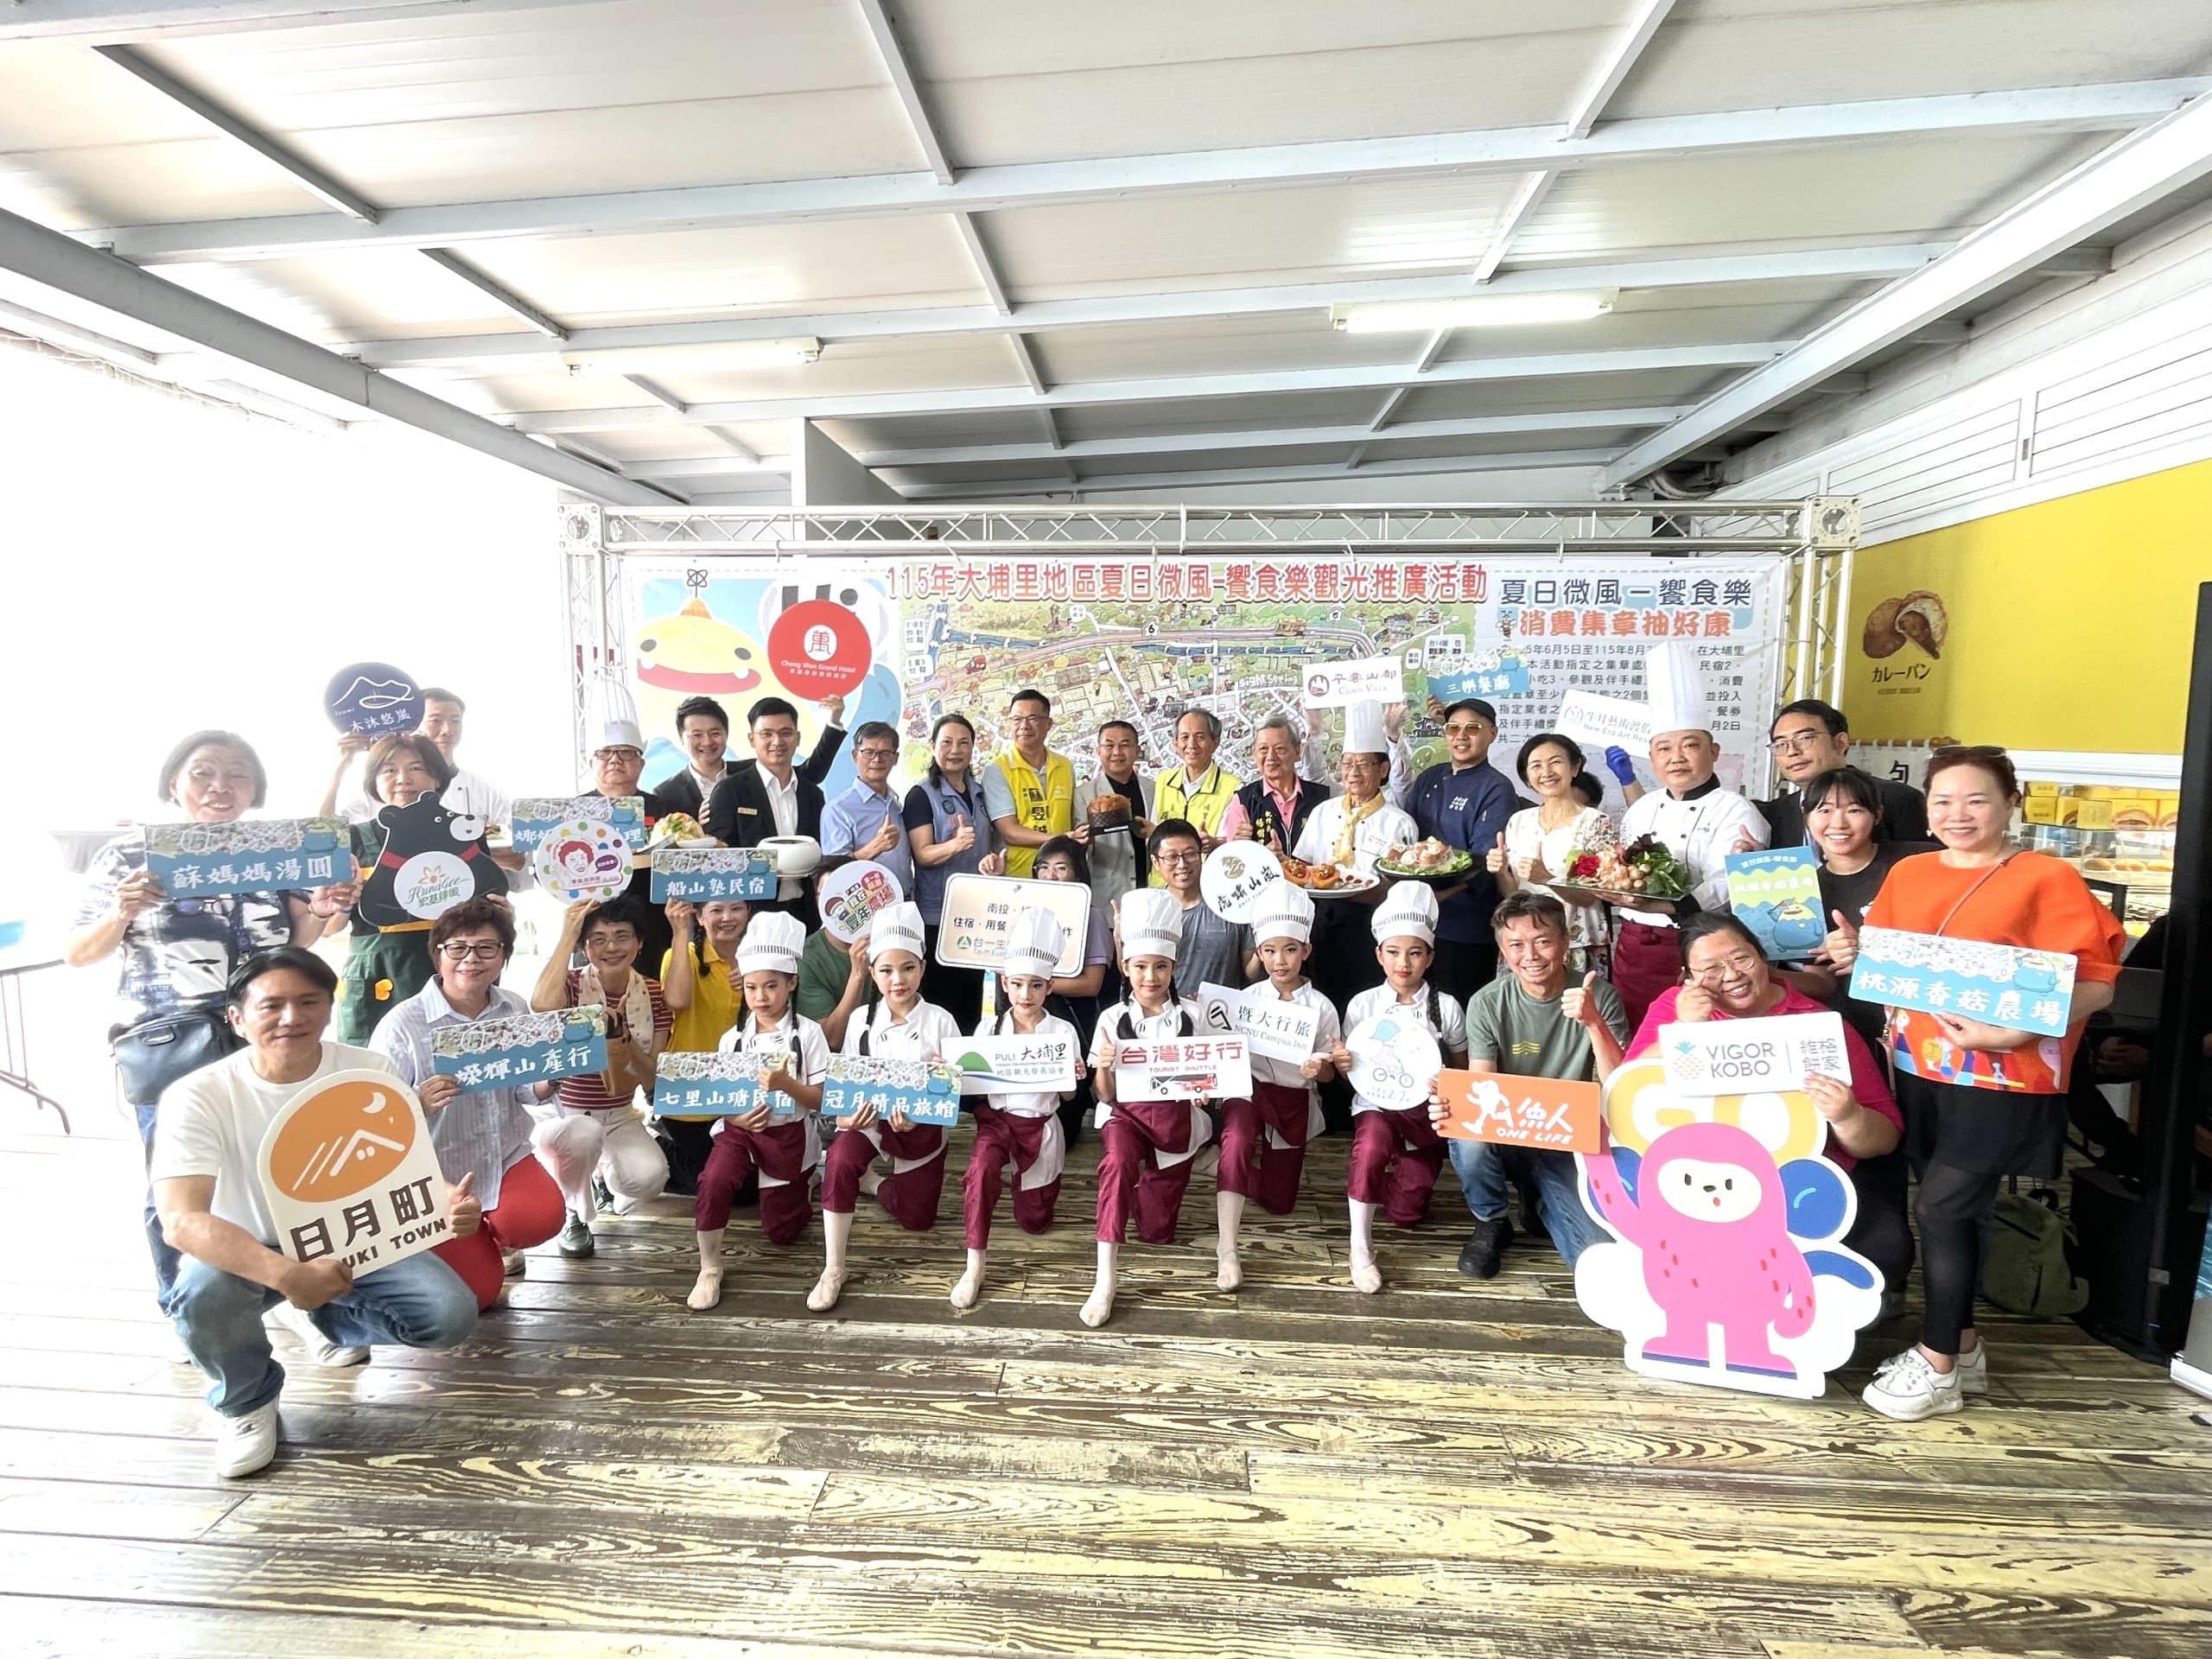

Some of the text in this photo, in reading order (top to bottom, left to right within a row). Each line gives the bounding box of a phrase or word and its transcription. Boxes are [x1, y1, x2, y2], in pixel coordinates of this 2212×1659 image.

[1147, 624, 1155, 635] 6
[1520, 609, 1732, 638] 消費集章抽好康
[807, 630, 832, 655] 萬
[172, 855, 334, 890] 蘇媽媽湯圓
[664, 876, 766, 897] 船山塾民宿
[973, 938, 1009, 950] 台一生
[1856, 969, 2064, 1028] 桃源香菇農場
[1238, 1005, 1312, 1038] 暨大行旅
[1234, 1024, 1260, 1038] NCNU
[1261, 1031, 1292, 1046] Campus
[995, 1053, 1016, 1062] PULI
[1020, 1042, 1067, 1062] 大埔里
[1121, 1041, 1243, 1065] 台灣好行
[1706, 1042, 1777, 1060] VIGOR
[1710, 1059, 1770, 1078] KOBO
[1496, 1127, 1573, 1145] ONE LIFE
[290, 1176, 435, 1262] 日月町
[341, 1217, 447, 1269] UKI TOWN
